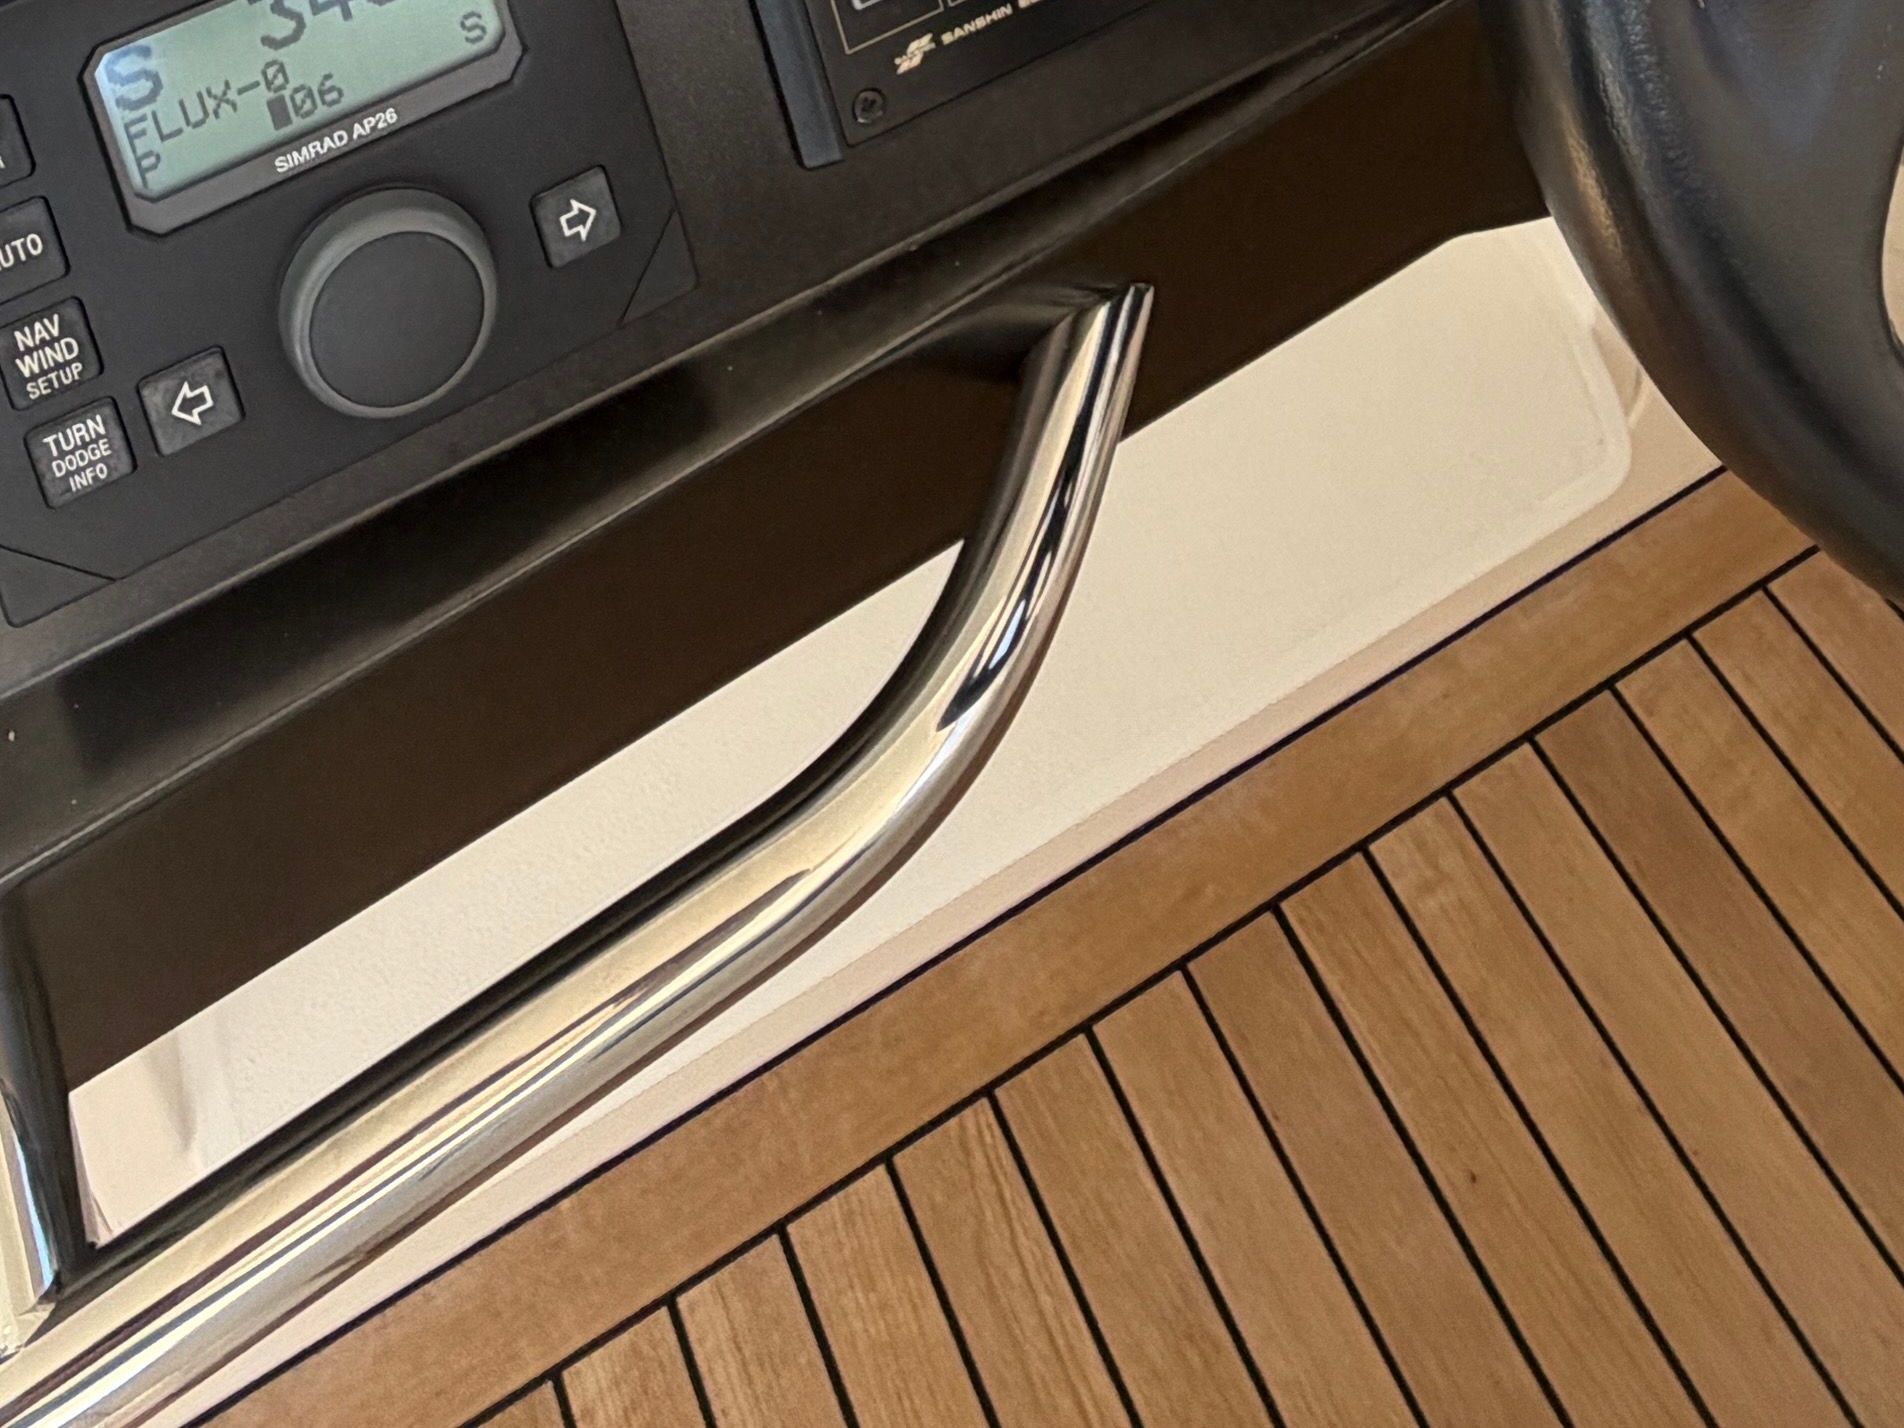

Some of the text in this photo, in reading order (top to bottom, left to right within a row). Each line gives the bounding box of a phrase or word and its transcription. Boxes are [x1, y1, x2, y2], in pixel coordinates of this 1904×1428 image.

[941, 2, 1013, 46] SANSHIN
[105, 43, 165, 112] S
[135, 152, 163, 190] P
[459, 9, 489, 45] S
[274, 107, 399, 174] SIMRAD AP26
[14, 313, 61, 350] NAV
[15, 337, 80, 379] WIND
[25, 361, 84, 401] SETUP
[42, 414, 107, 458] TURN
[51, 439, 112, 479] DODGE
[68, 462, 109, 493] INFO
